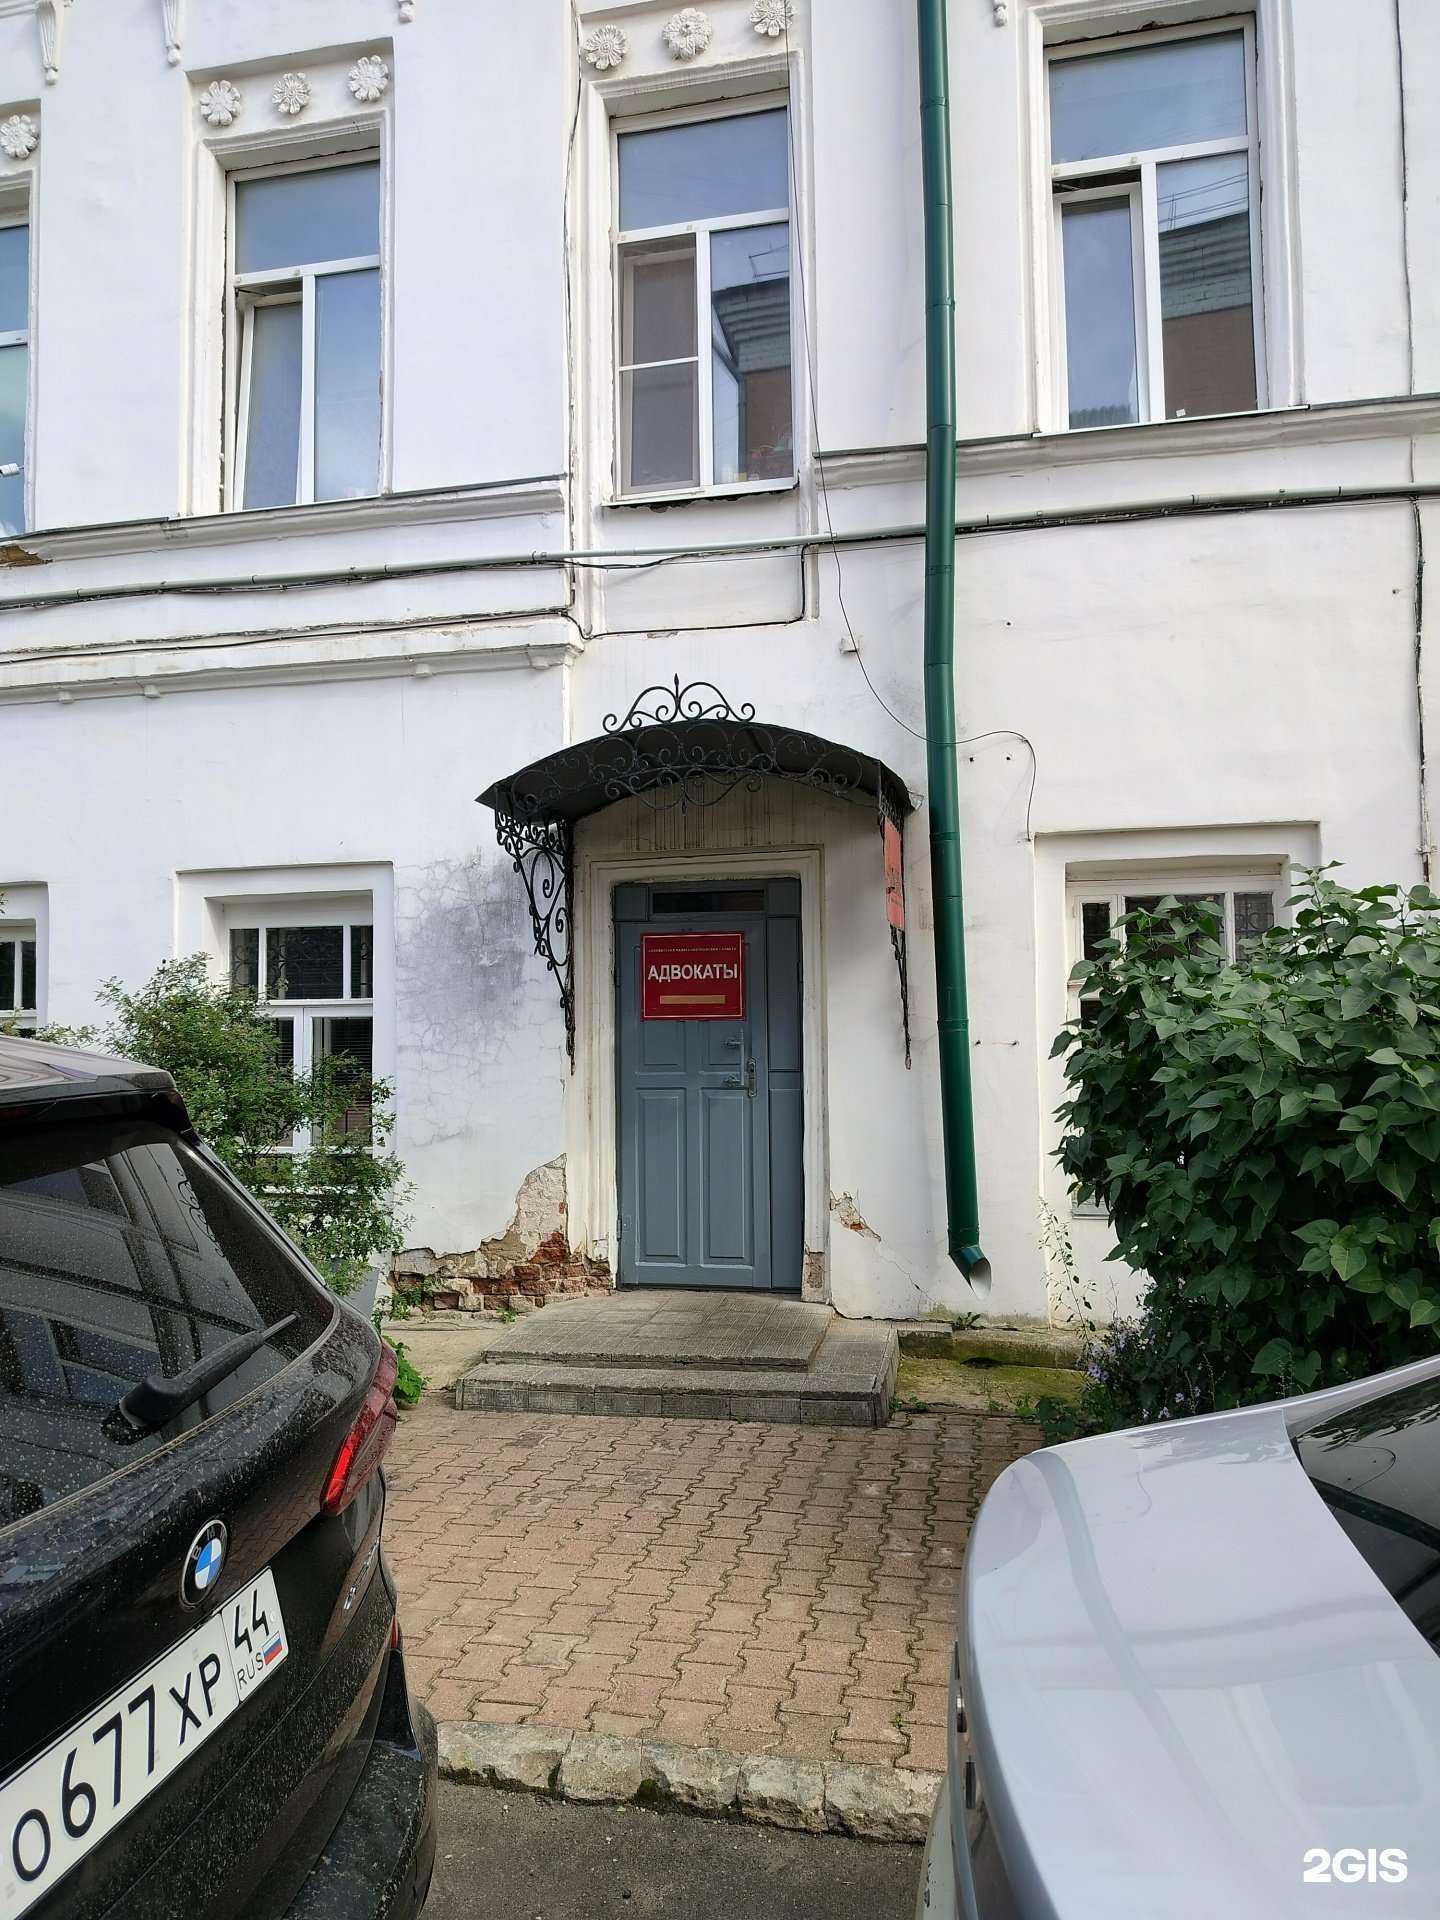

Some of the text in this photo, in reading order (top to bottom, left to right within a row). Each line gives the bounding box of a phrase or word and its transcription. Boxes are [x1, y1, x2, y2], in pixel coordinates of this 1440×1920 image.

[648, 963, 738, 982] АДВОКАТЫ
[234, 1589, 270, 1654] 44
[237, 1652, 264, 1690] RUS
